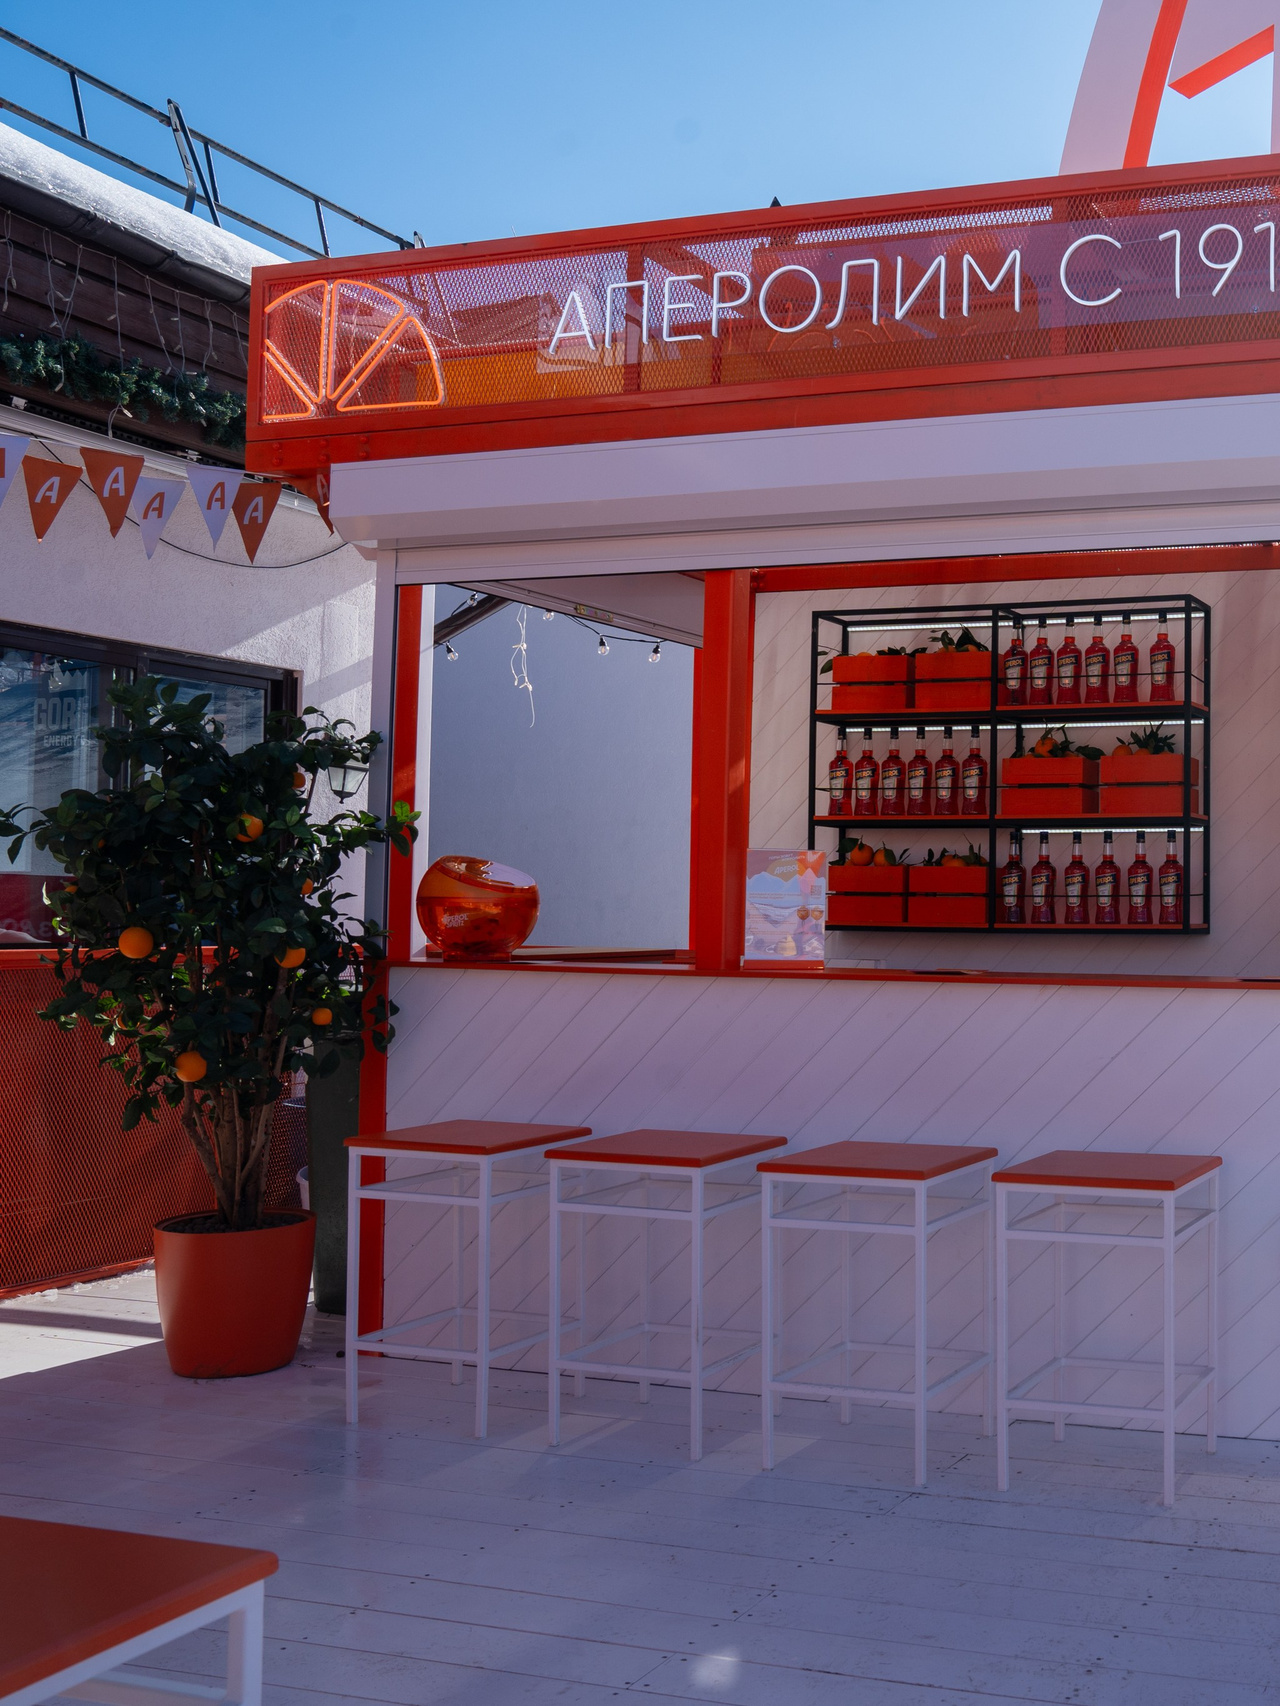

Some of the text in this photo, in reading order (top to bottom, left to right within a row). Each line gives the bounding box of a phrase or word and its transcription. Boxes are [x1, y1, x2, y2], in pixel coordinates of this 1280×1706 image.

[549, 249, 1021, 354] АПЕРОЛИМ
[1060, 234, 1122, 306] С
[35, 476, 60, 504] A
[103, 466, 125, 498] A
[206, 481, 226, 510] A
[142, 491, 165, 520] A
[243, 496, 264, 525] A
